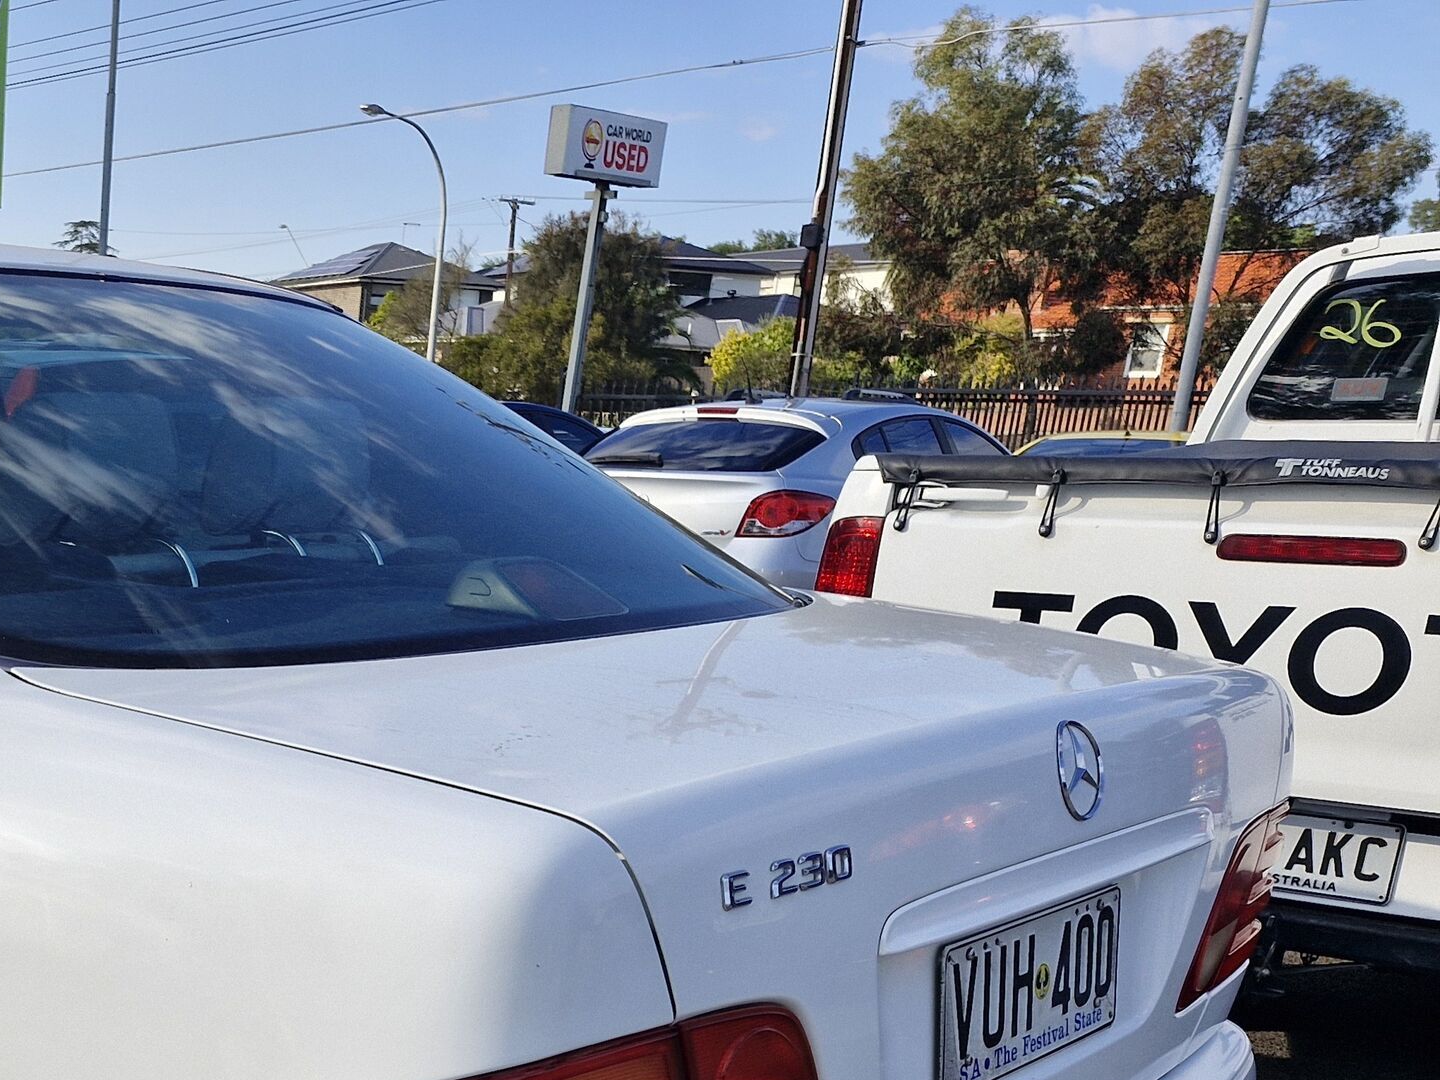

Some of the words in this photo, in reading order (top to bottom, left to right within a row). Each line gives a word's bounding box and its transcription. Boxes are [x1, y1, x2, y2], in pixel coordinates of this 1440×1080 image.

[603, 140, 649, 173] USED
[606, 124, 625, 139] CAR
[625, 126, 652, 143] WORLD
[1319, 298, 1402, 348] 26
[1301, 465, 1391, 480] TONNEAUS
[1305, 458, 1342, 467] TUFF
[992, 590, 1440, 715] TYO
[720, 869, 753, 912] E
[769, 843, 853, 900] 230
[1284, 828, 1388, 882] AKC
[1268, 872, 1337, 892] STRALIA
[952, 933, 1036, 1060] VUH
[1051, 904, 1115, 1016] 400
[993, 1045, 1018, 1069] The
[1022, 1018, 1069, 1057] Festival
[1073, 1007, 1103, 1032] State
